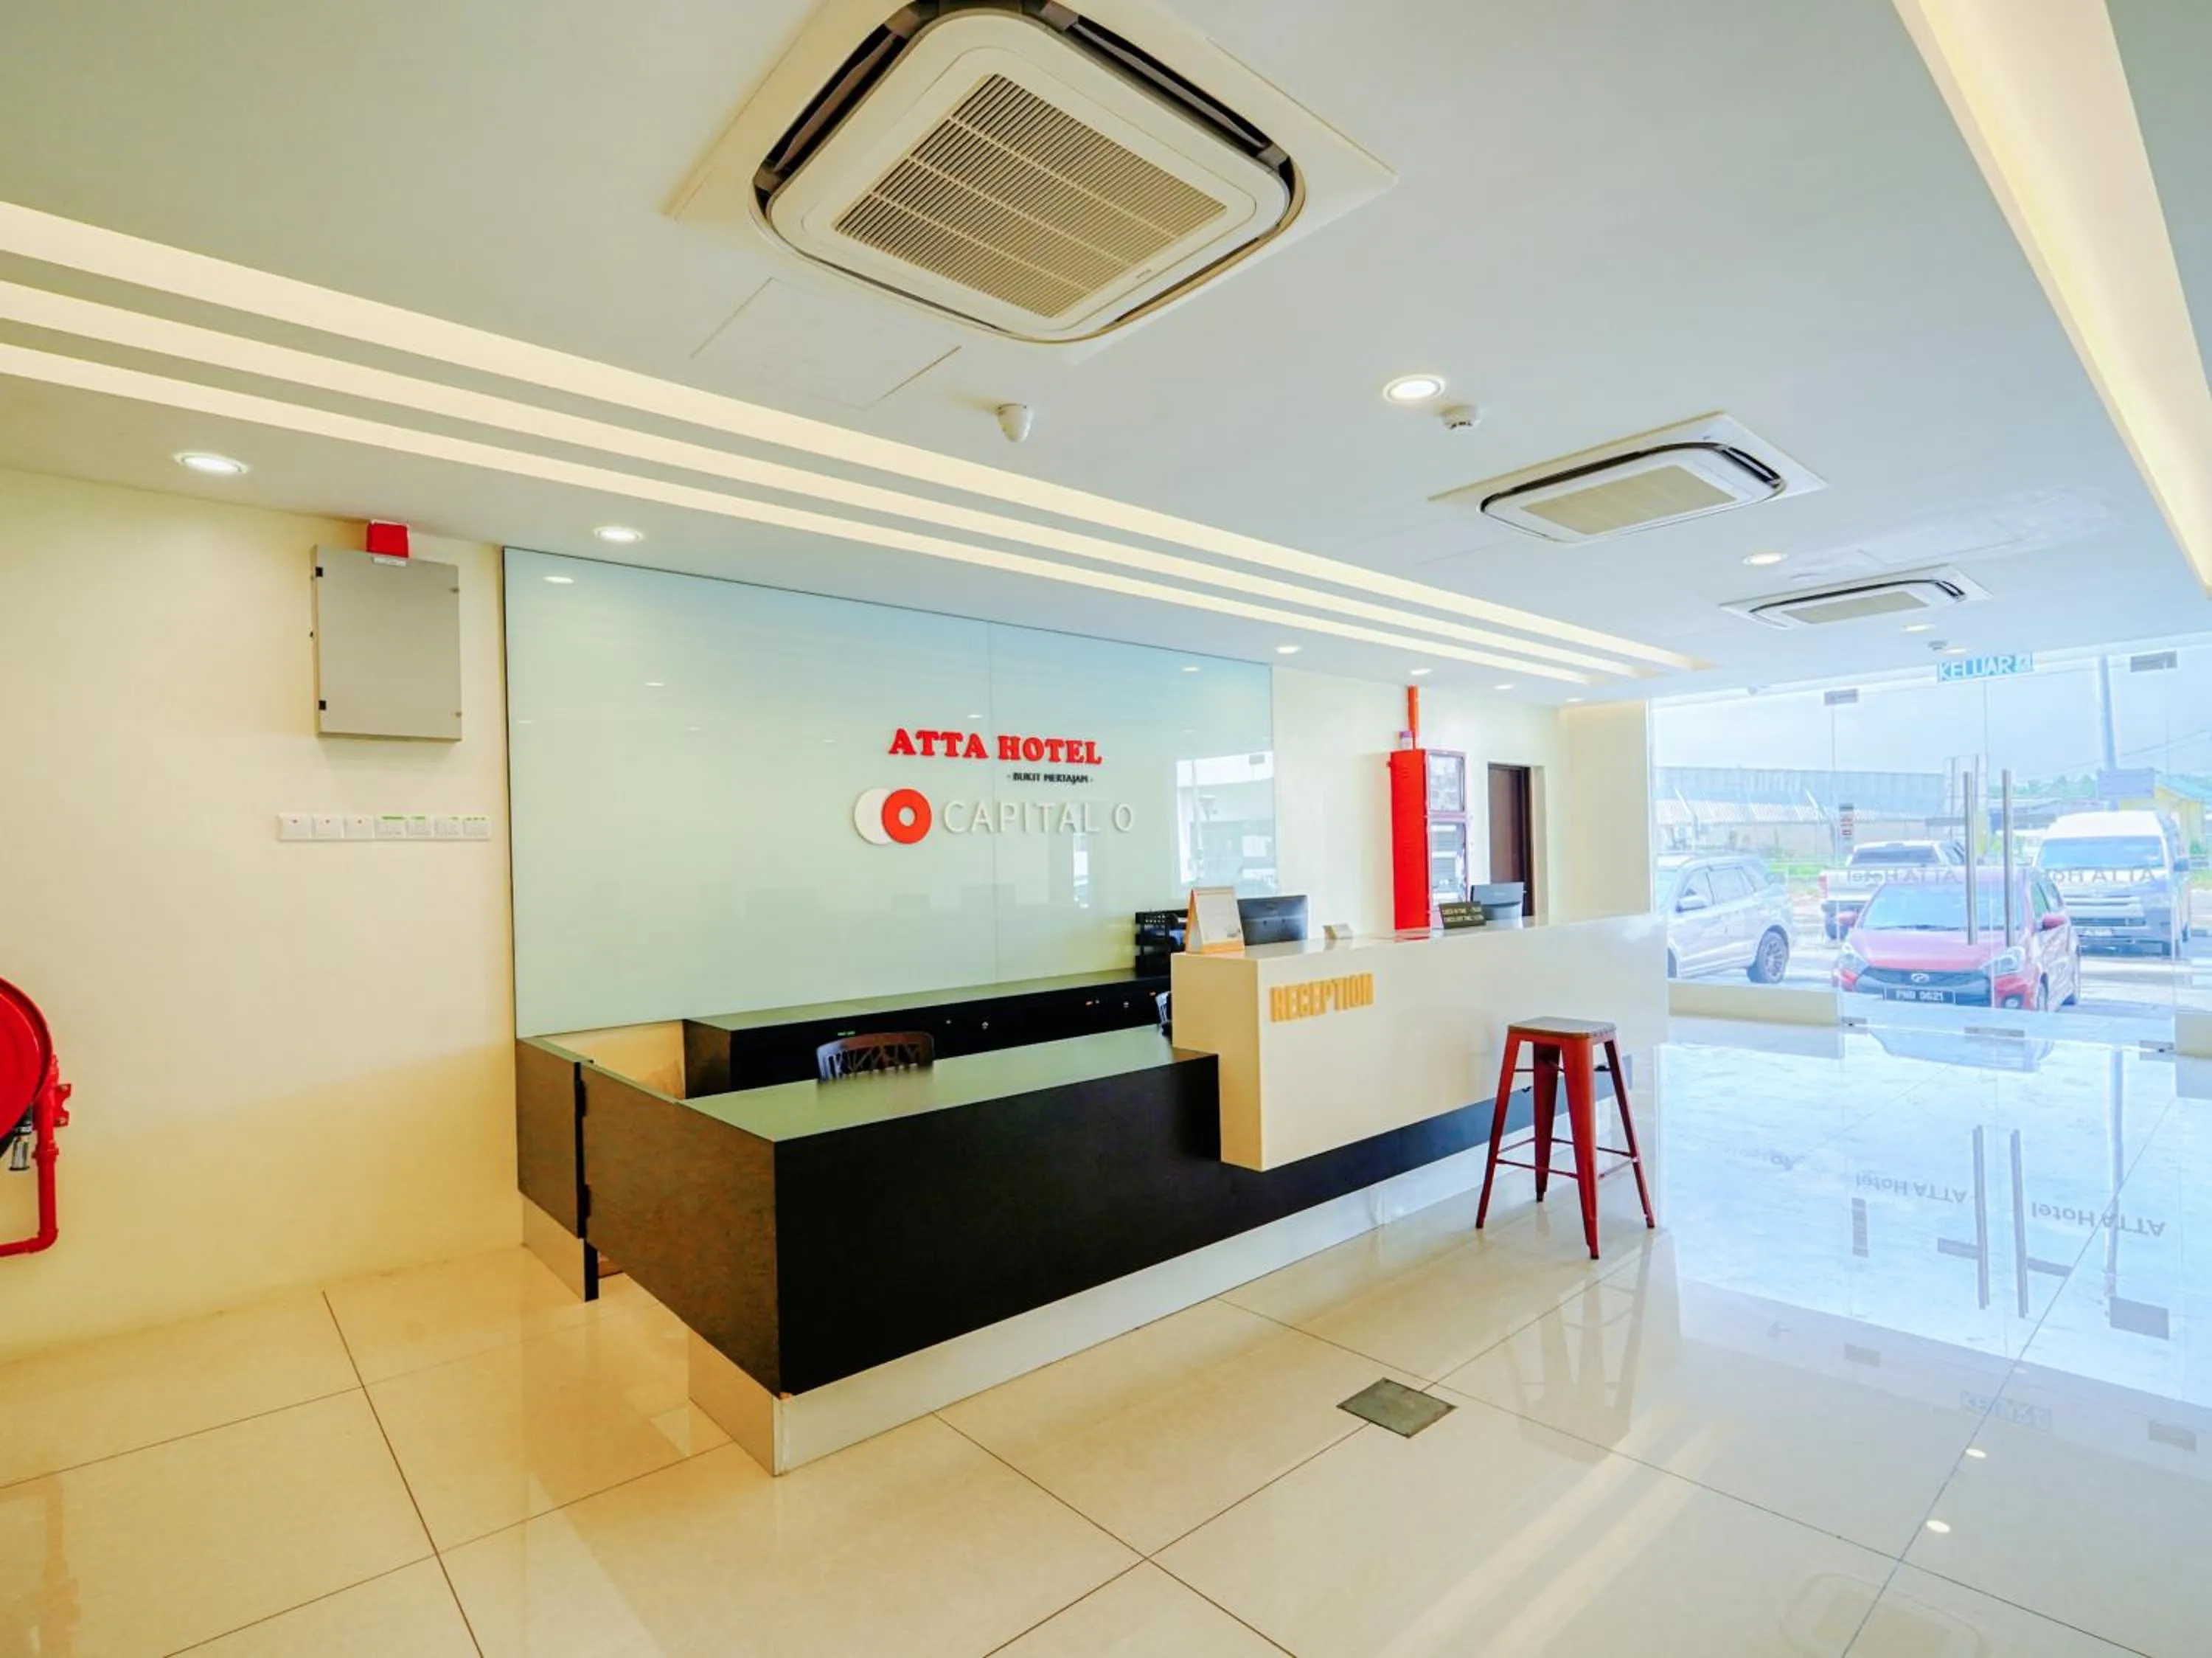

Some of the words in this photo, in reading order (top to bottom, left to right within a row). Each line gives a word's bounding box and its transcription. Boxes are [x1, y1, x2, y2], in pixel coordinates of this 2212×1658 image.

[1938, 656, 2014, 681] KELUAR
[888, 728, 989, 759] ATTA
[997, 735, 1102, 765] HOTEL
[1013, 771, 1040, 782] BUKIT
[1043, 773, 1088, 785] MERTAJAM
[943, 799, 1101, 835] CAPITAL
[1113, 802, 1136, 834] O
[1270, 972, 1374, 1024] RECEPTION
